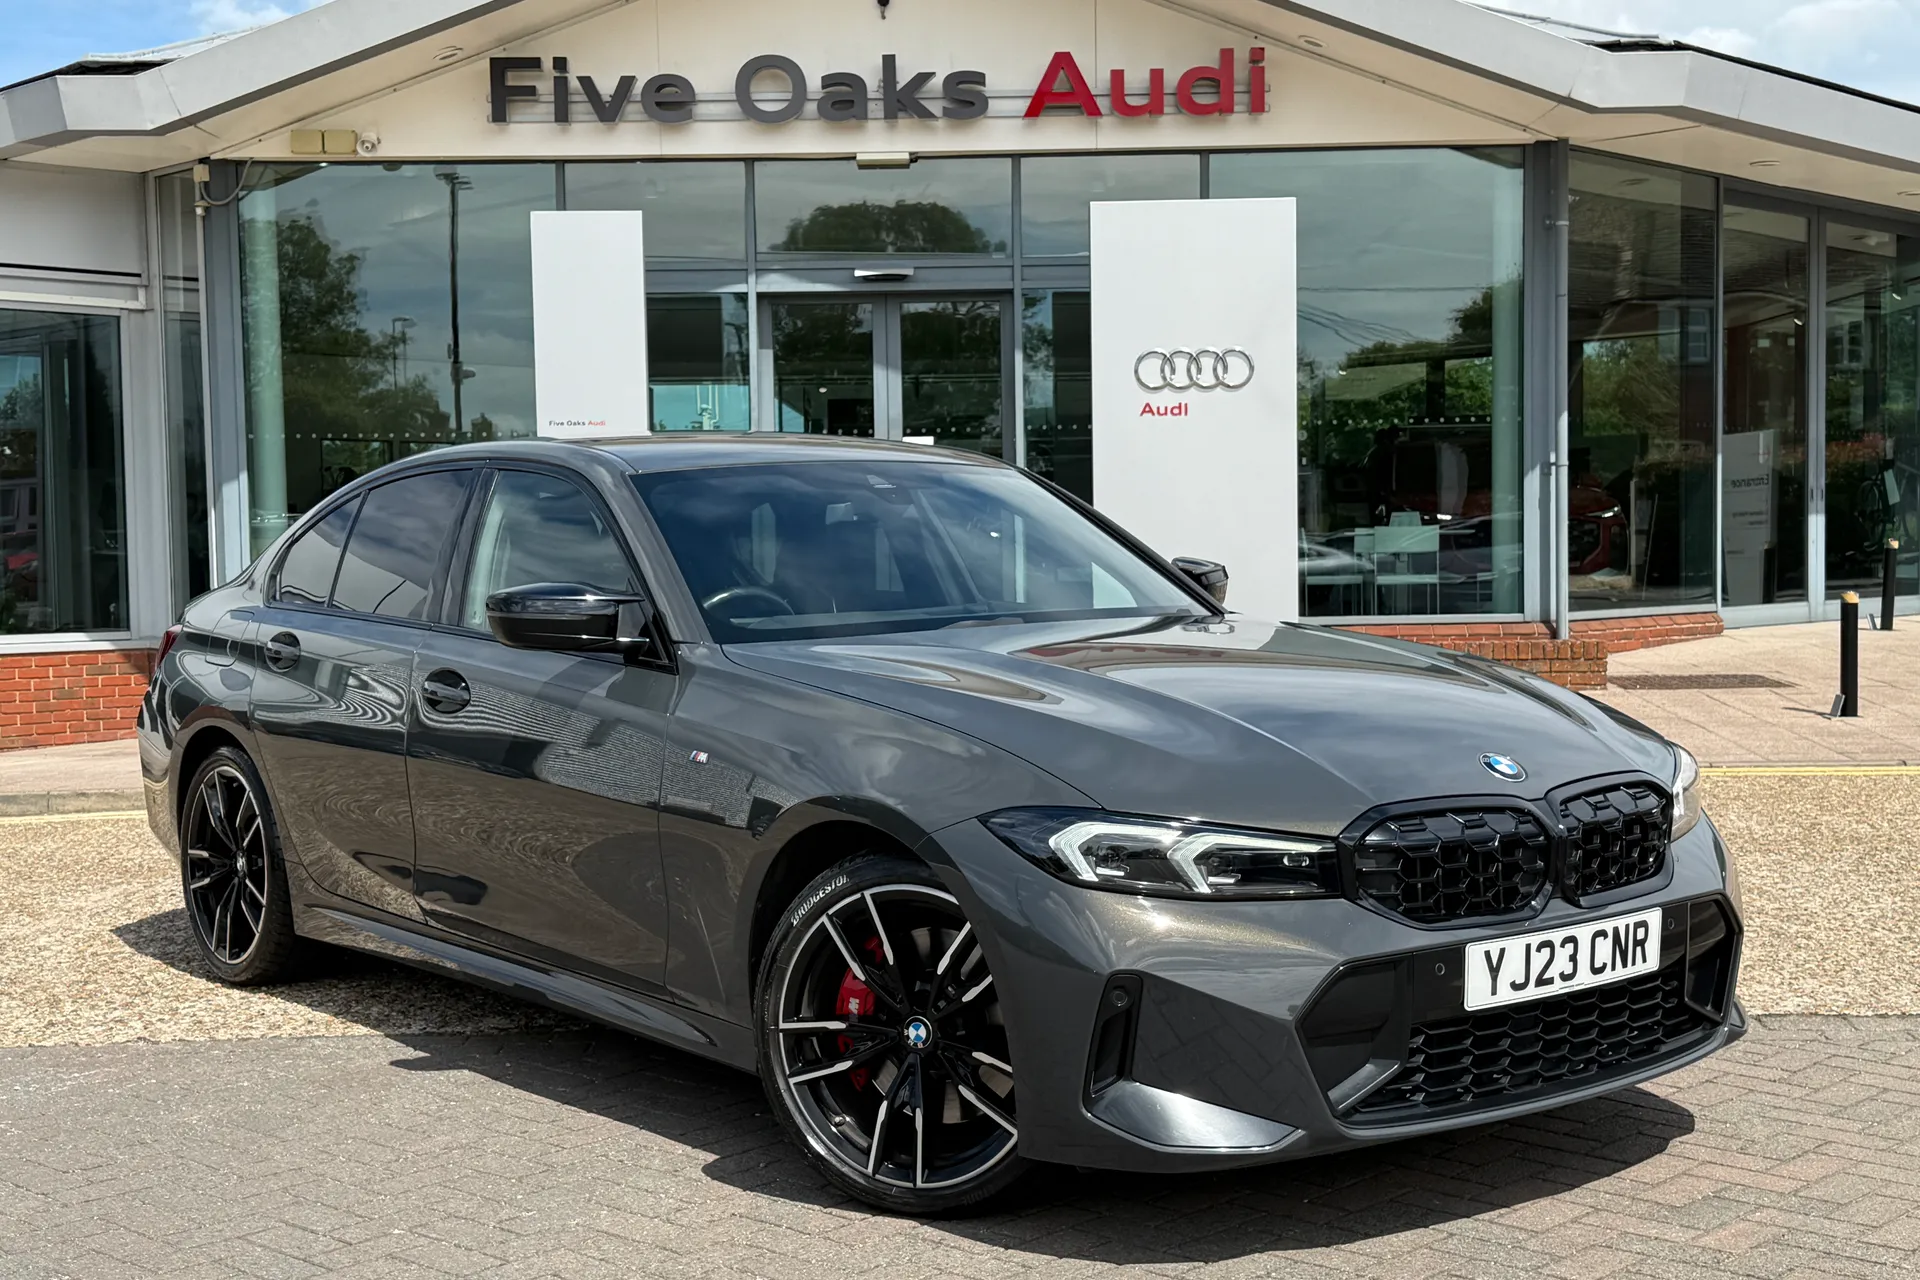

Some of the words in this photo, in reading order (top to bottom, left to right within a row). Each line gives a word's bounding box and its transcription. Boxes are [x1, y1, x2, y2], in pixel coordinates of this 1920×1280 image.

[489, 56, 697, 125] Five
[735, 54, 989, 123] Oaks
[1023, 47, 1266, 119] Audi
[1140, 402, 1188, 416] Audi
[1484, 935, 1579, 996] YJ23
[1590, 919, 1649, 976] CNR
